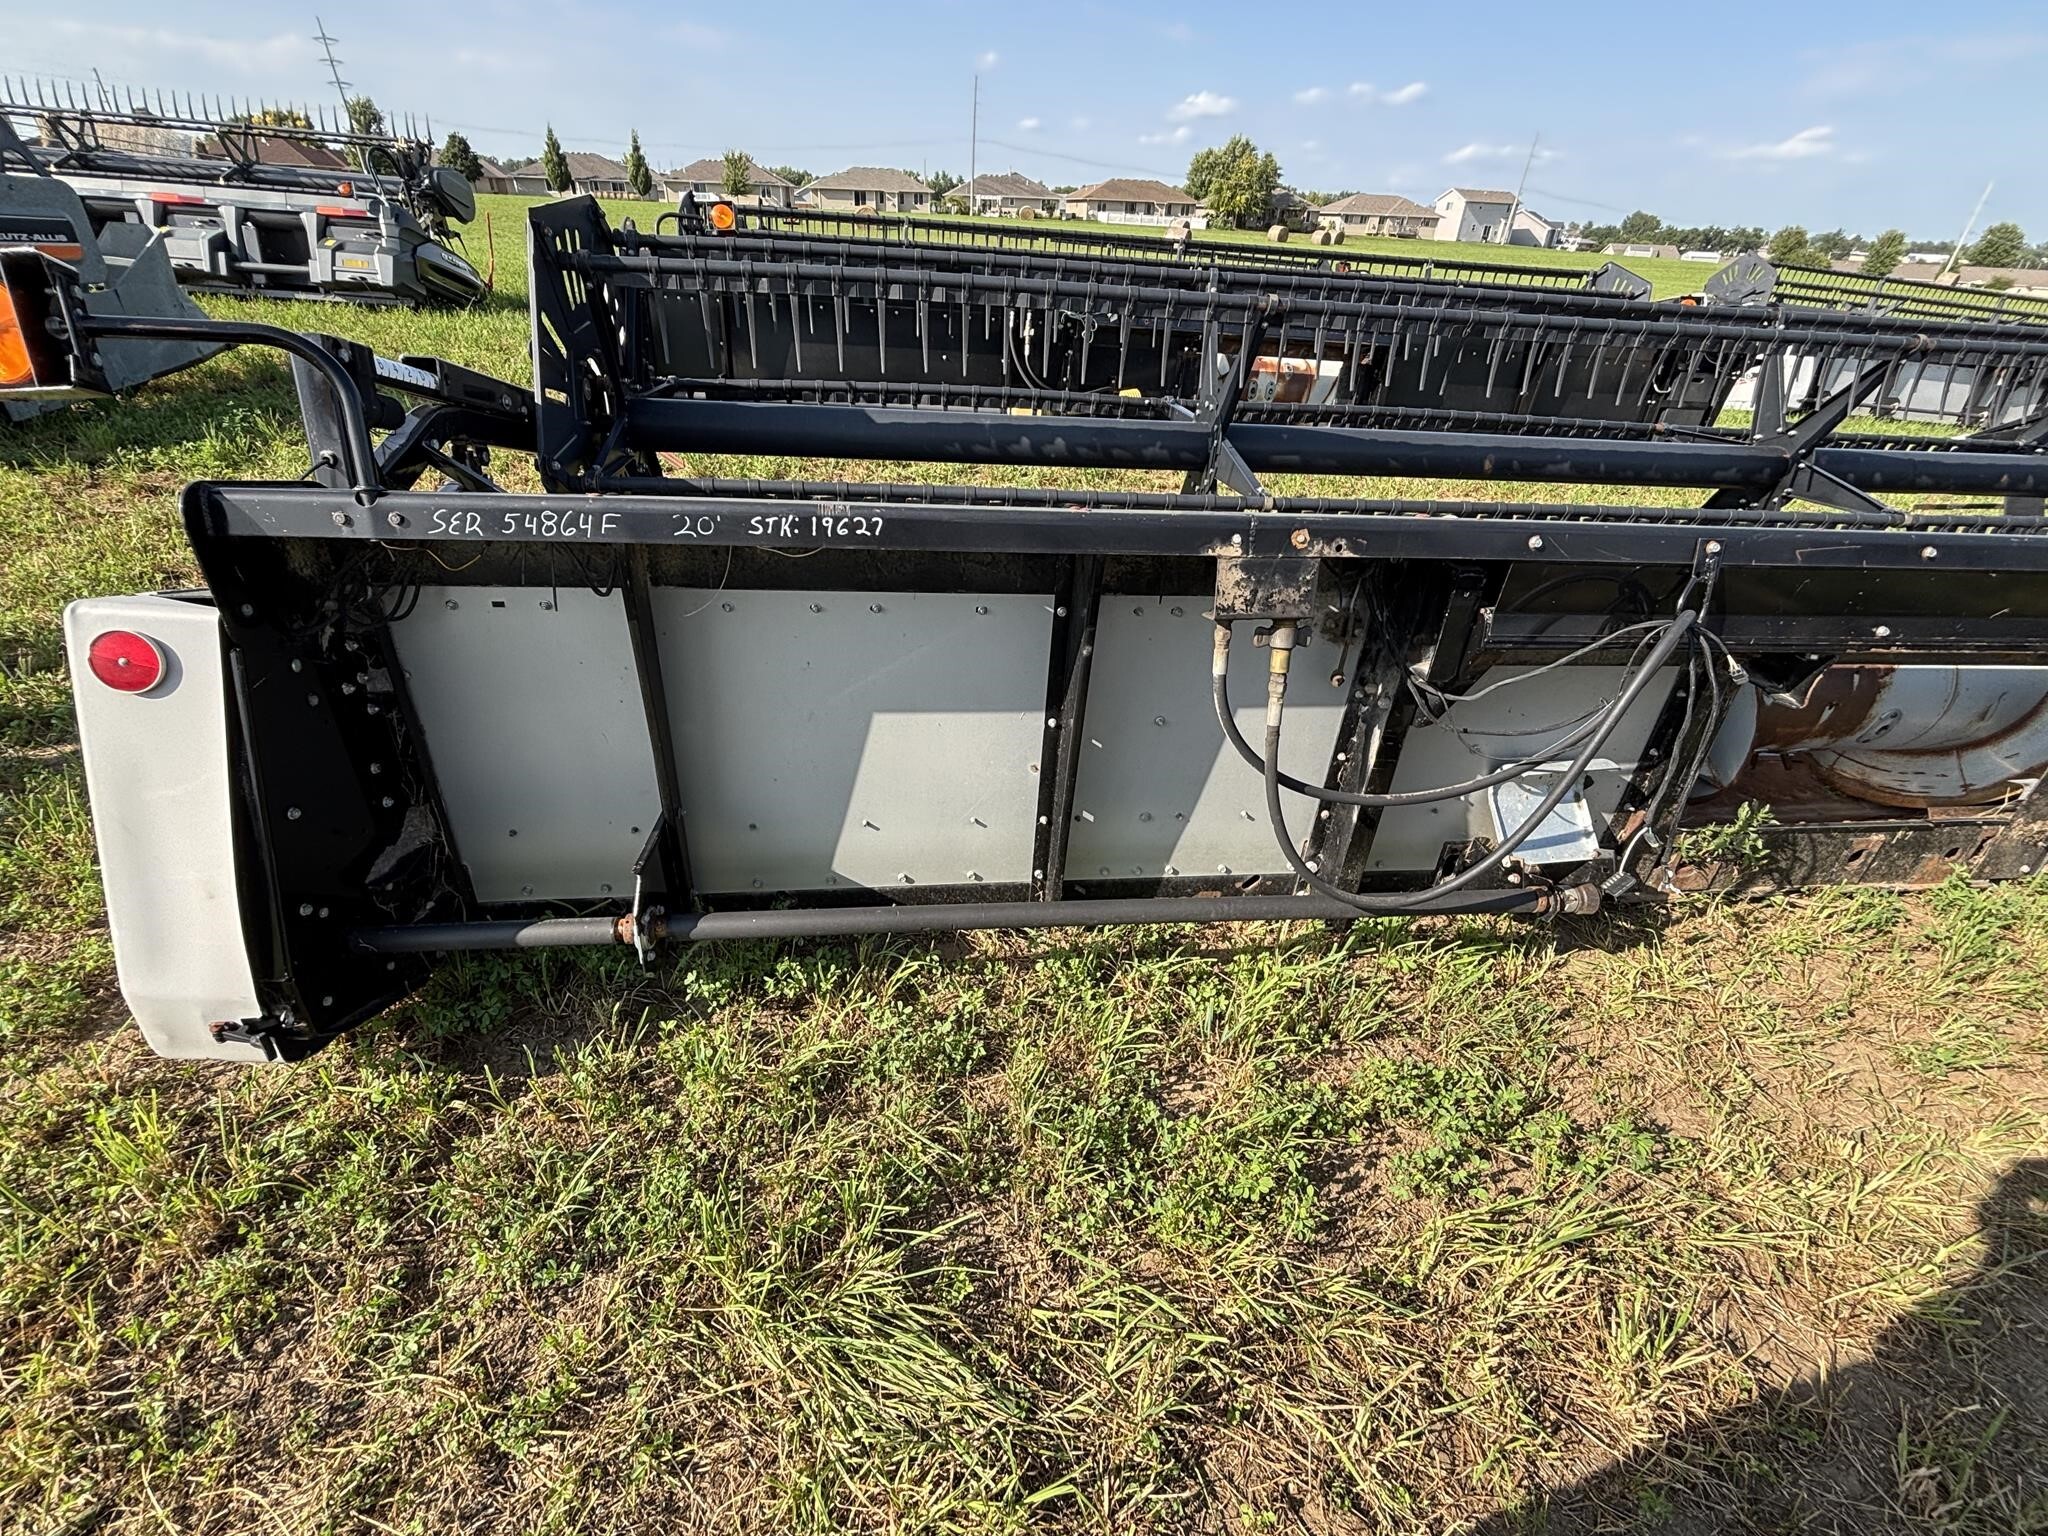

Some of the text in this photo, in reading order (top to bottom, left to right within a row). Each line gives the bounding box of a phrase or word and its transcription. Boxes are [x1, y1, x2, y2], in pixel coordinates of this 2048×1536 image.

[427, 508, 484, 537] SER
[501, 510, 622, 539] 54864F
[748, 514, 799, 538] STK:
[811, 516, 883, 538] 19627
